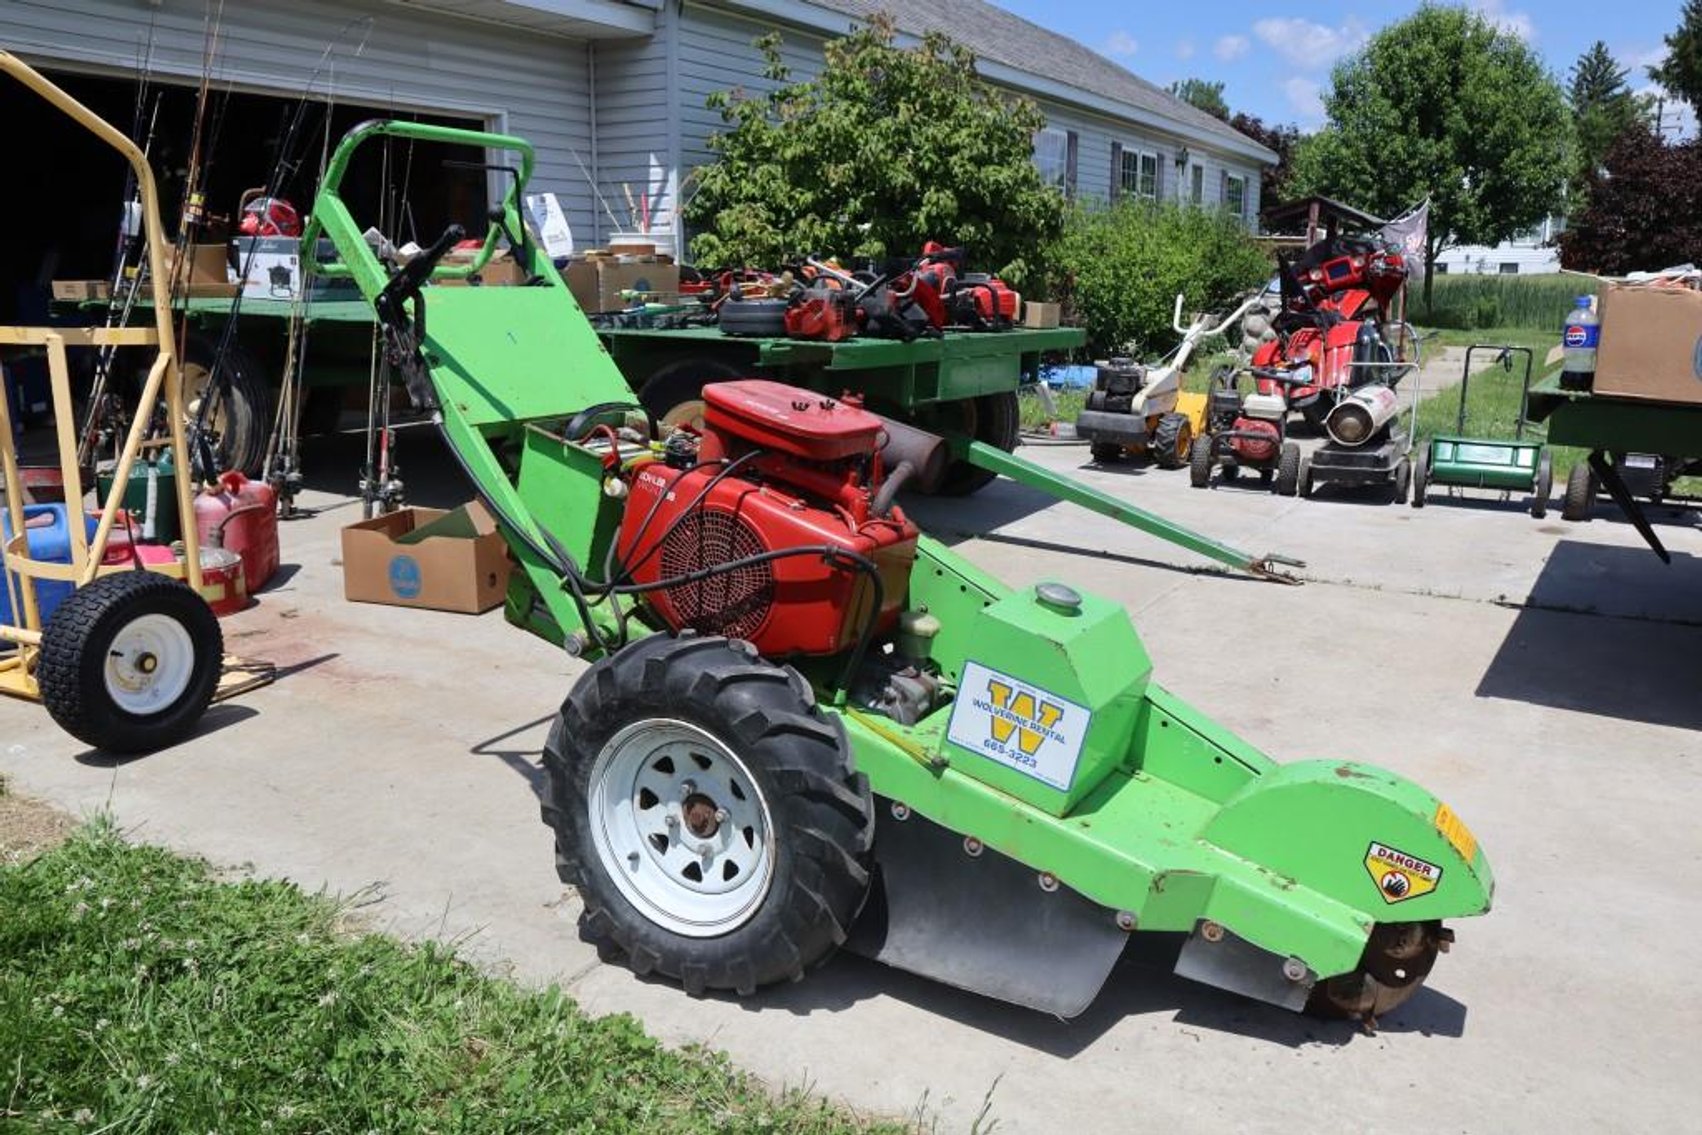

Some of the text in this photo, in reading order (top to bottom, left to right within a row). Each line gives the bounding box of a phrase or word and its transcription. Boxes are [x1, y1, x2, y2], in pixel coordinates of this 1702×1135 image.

[972, 697, 1066, 745] WOLVERINE RENTAL
[983, 738, 1038, 769] 665-3223
[1377, 847, 1432, 875] DANGER
